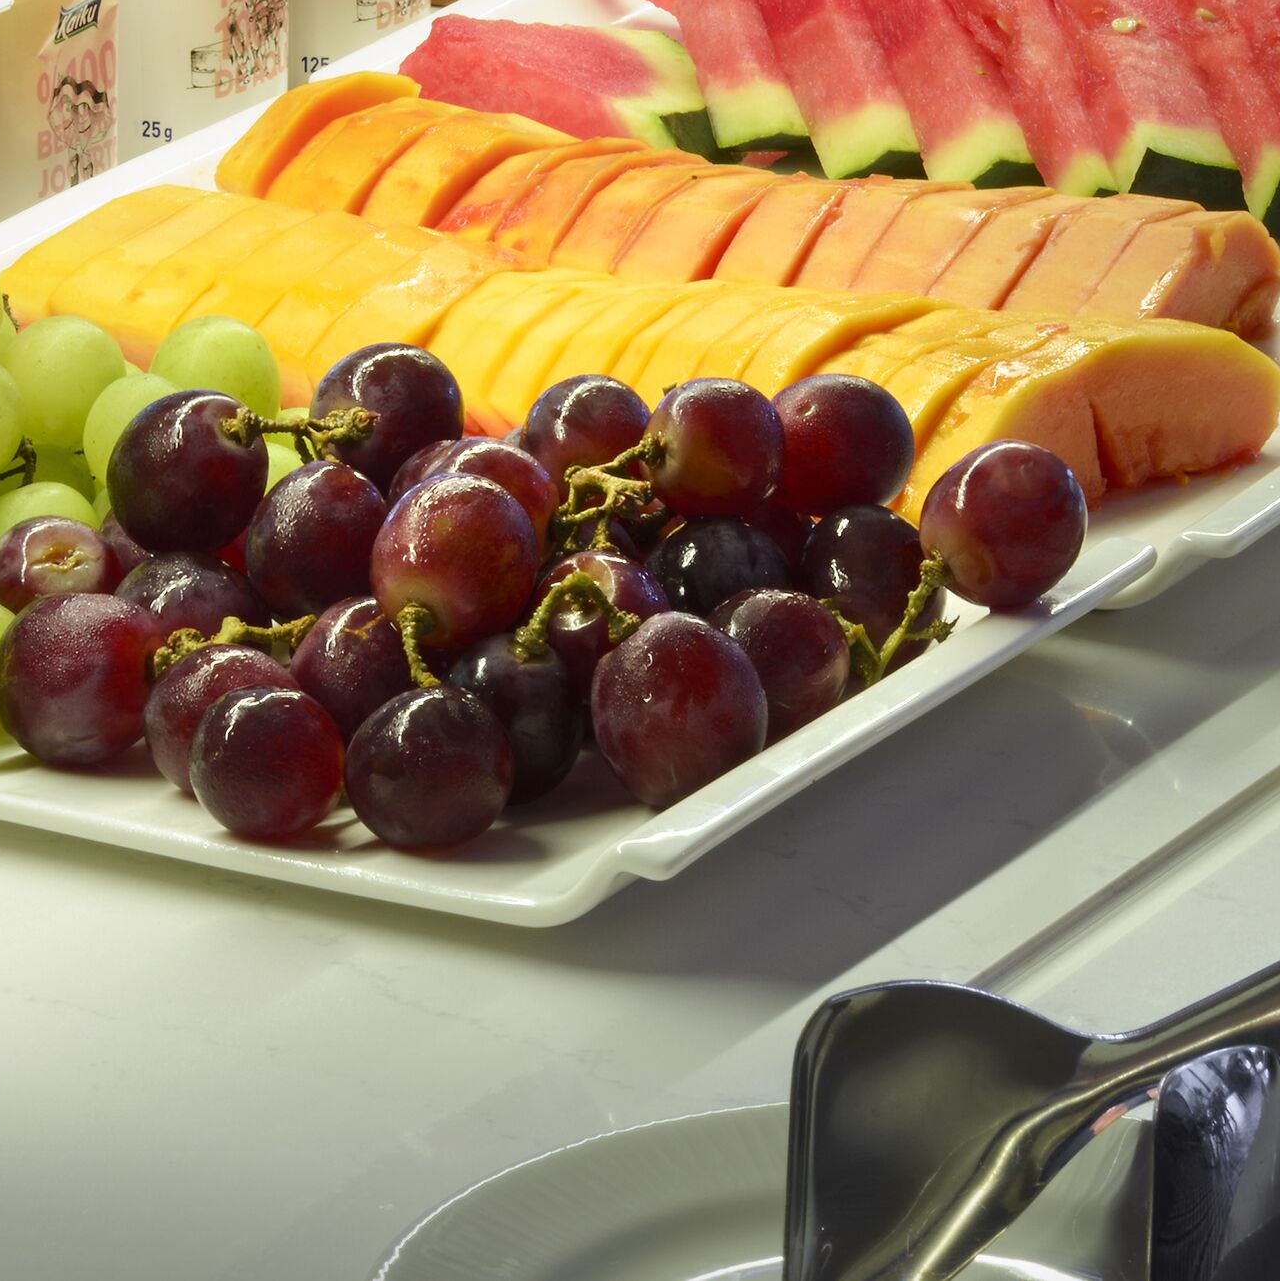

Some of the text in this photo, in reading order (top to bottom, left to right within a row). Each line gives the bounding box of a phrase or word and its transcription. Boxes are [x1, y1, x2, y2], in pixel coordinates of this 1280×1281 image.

[57, 2, 99, 41] Kaiku
[141, 120, 173, 143] 25 g
